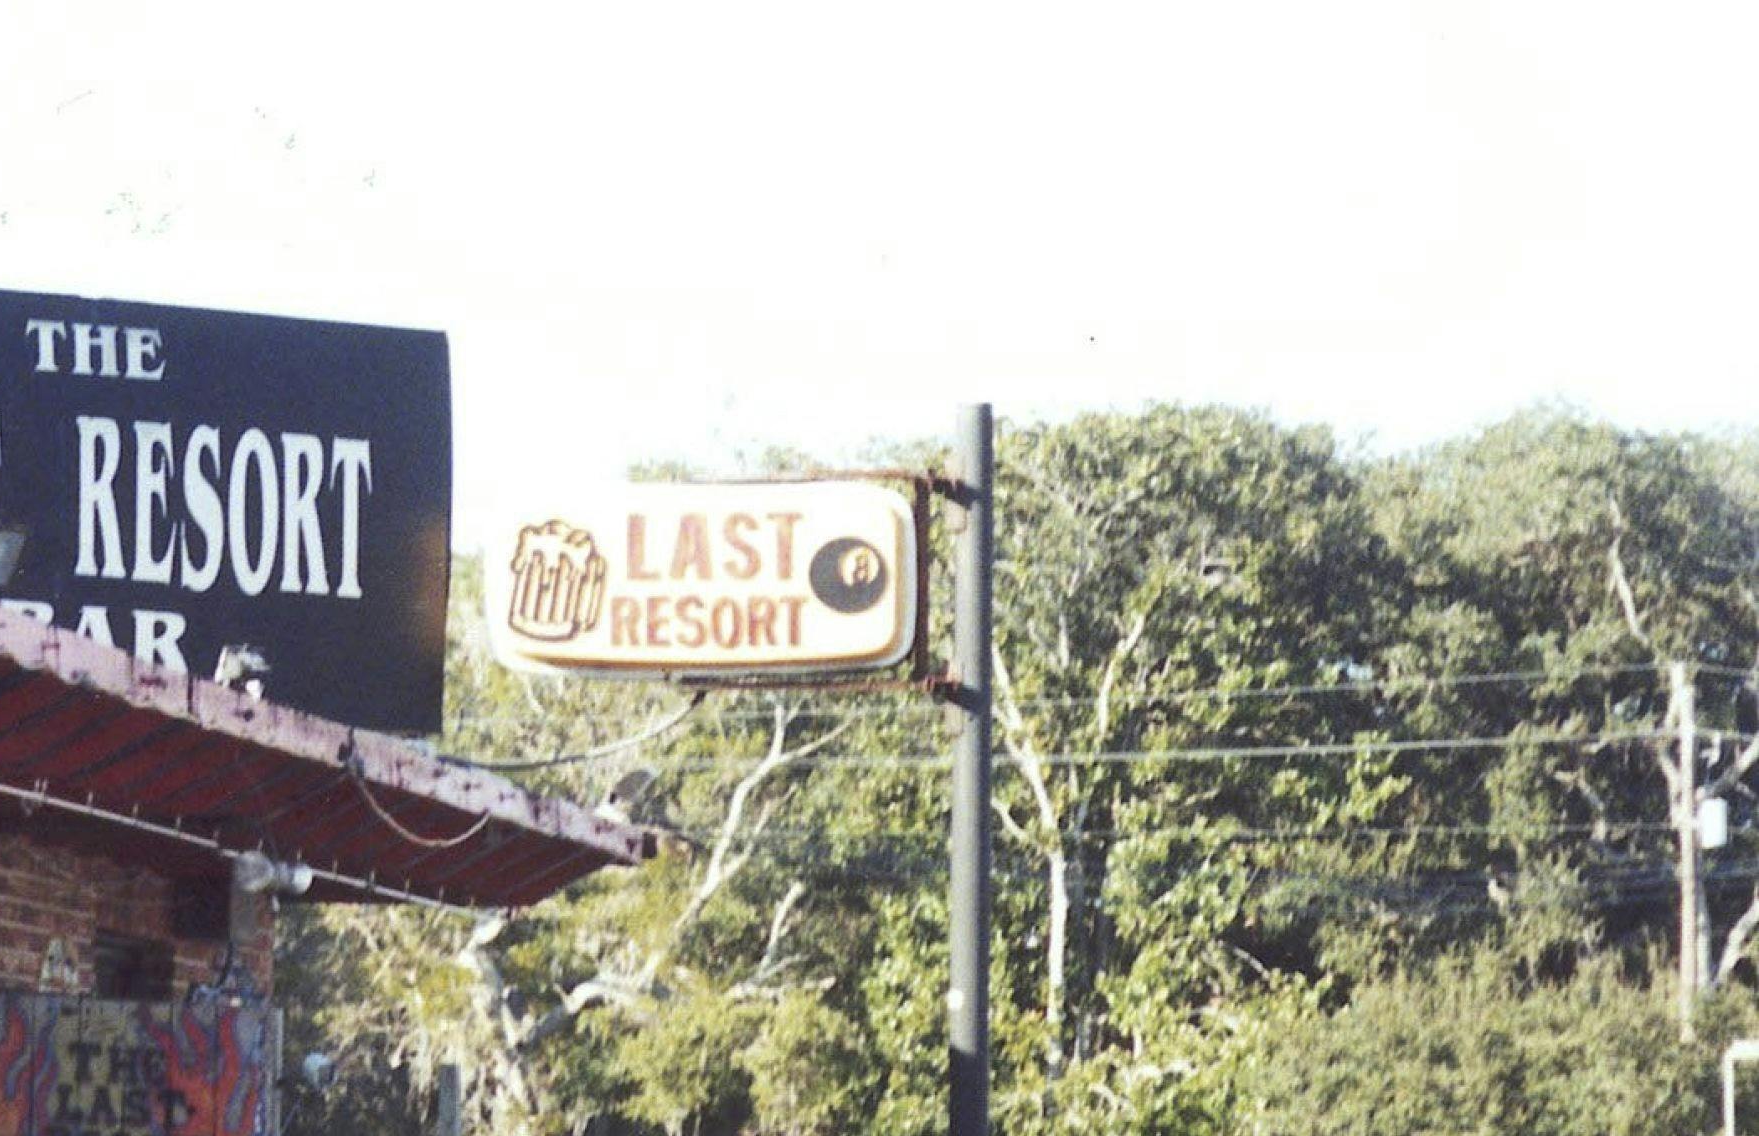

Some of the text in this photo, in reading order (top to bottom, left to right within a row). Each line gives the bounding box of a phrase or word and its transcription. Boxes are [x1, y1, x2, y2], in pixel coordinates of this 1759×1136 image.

[25, 319, 167, 381] THE
[73, 415, 373, 600] RESORT
[626, 512, 803, 582] LAST
[610, 595, 809, 648] RESORT
